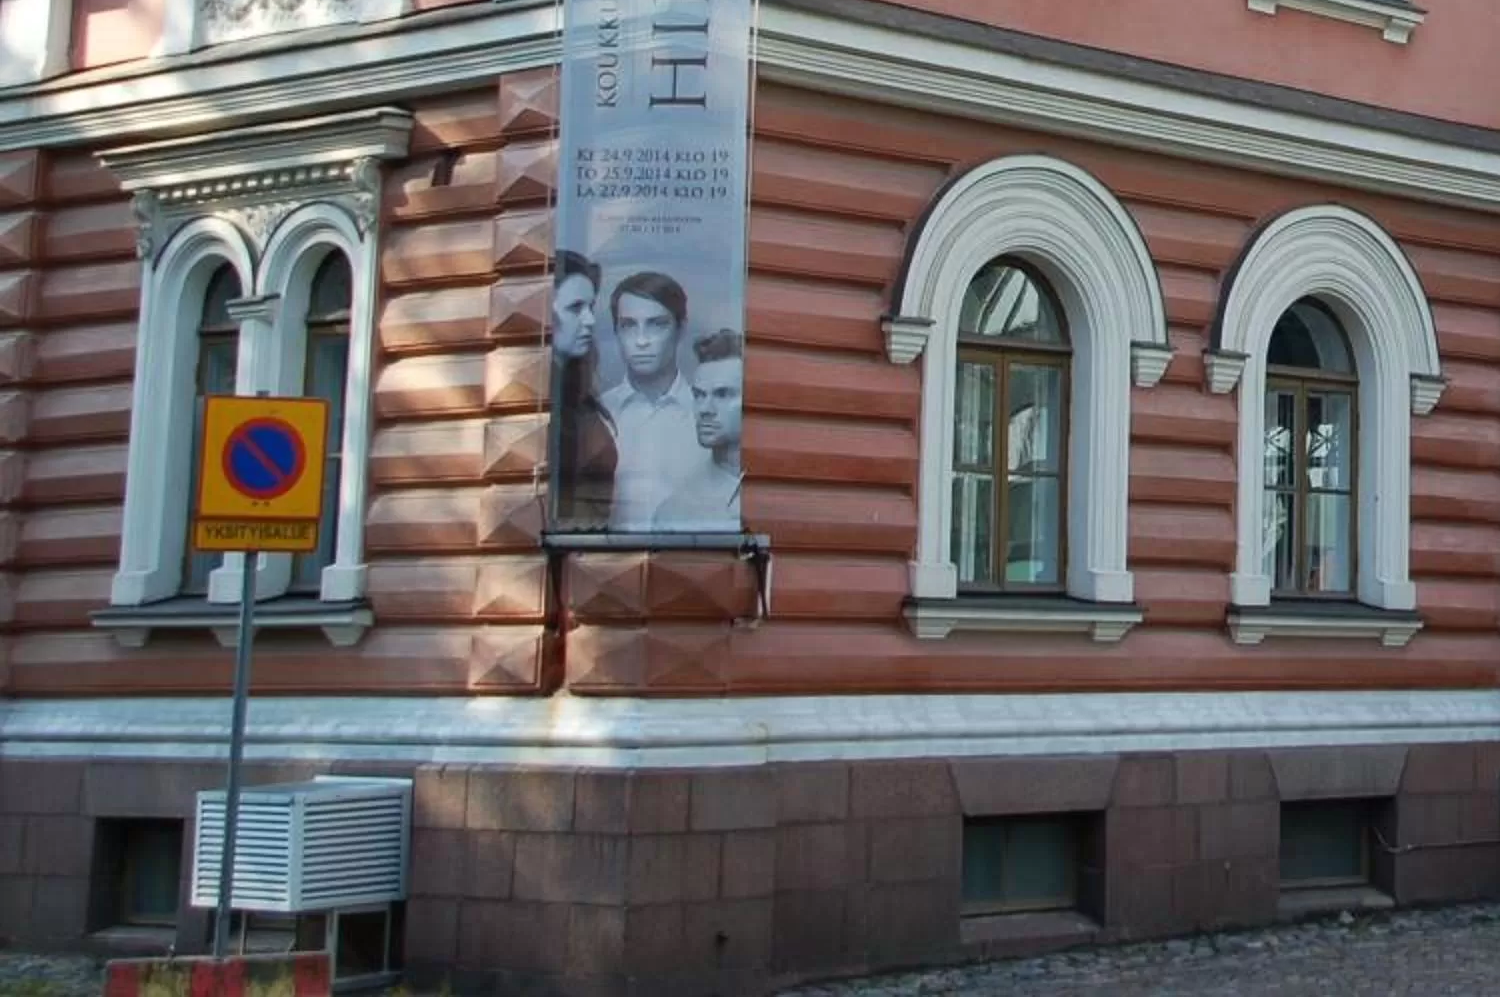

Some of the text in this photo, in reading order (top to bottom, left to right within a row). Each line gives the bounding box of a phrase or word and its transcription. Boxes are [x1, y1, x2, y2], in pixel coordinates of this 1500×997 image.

[712, 148, 729, 163] 19
[576, 166, 597, 181] TO
[602, 166, 671, 181] 25.9.2014
[712, 167, 730, 182] 19
[576, 184, 596, 199] LA
[710, 185, 728, 200] 19
